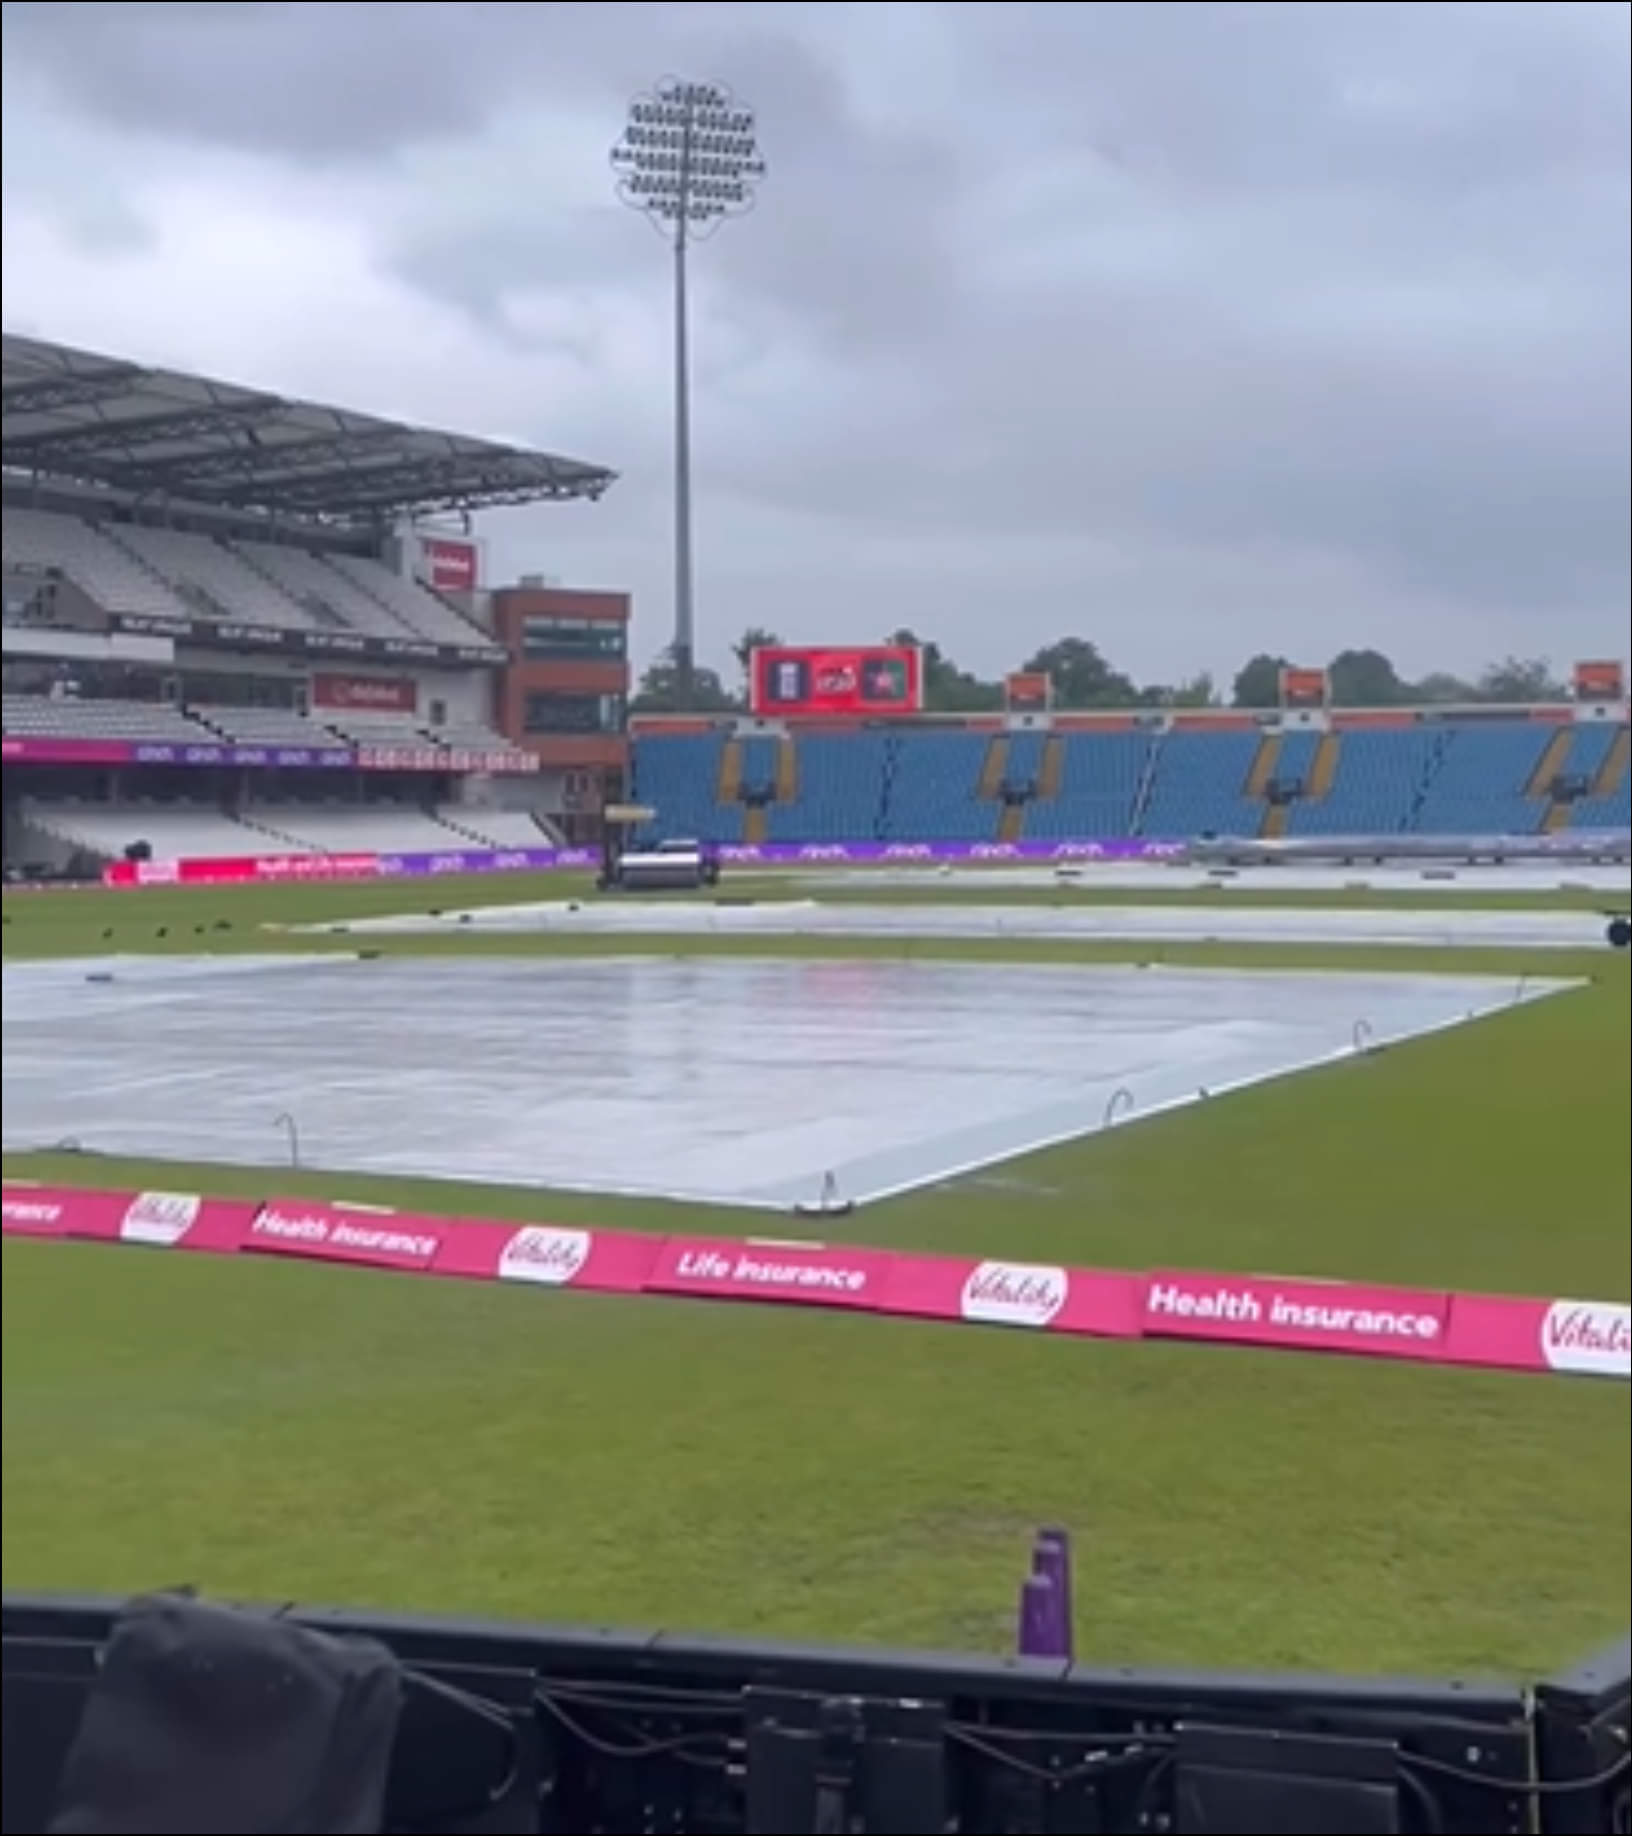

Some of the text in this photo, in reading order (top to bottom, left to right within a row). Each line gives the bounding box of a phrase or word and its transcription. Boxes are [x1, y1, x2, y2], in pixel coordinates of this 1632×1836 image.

[251, 1208, 438, 1256] Health insurance
[676, 1251, 867, 1291] Life insurance
[968, 1267, 1059, 1309] Vitality
[1149, 1284, 1439, 1338] Health insurance
